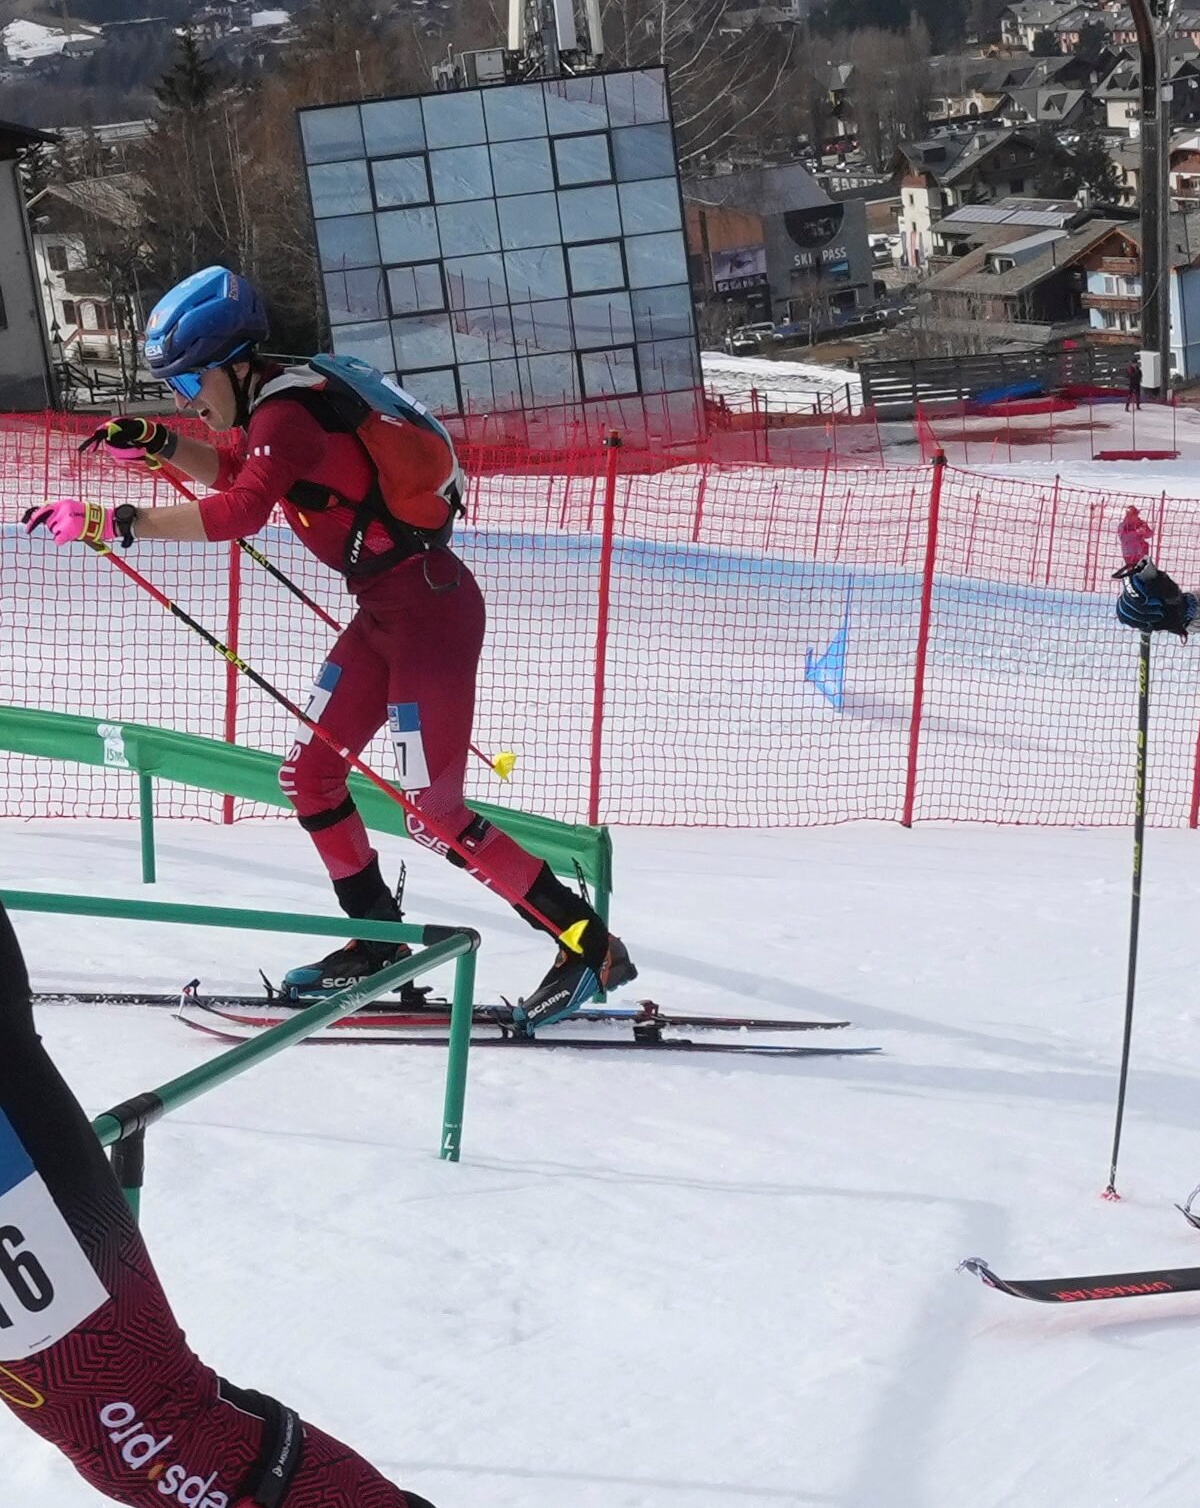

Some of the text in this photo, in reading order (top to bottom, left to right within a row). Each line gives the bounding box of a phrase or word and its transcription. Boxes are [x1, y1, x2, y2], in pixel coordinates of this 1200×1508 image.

[794, 247, 847, 267] SKI PASS
[350, 530, 364, 564] CAMP
[214, 643, 250, 673] LEKI
[278, 744, 302, 797] SUI
[405, 790, 451, 857] SPOT
[527, 989, 570, 1019] SCARPA
